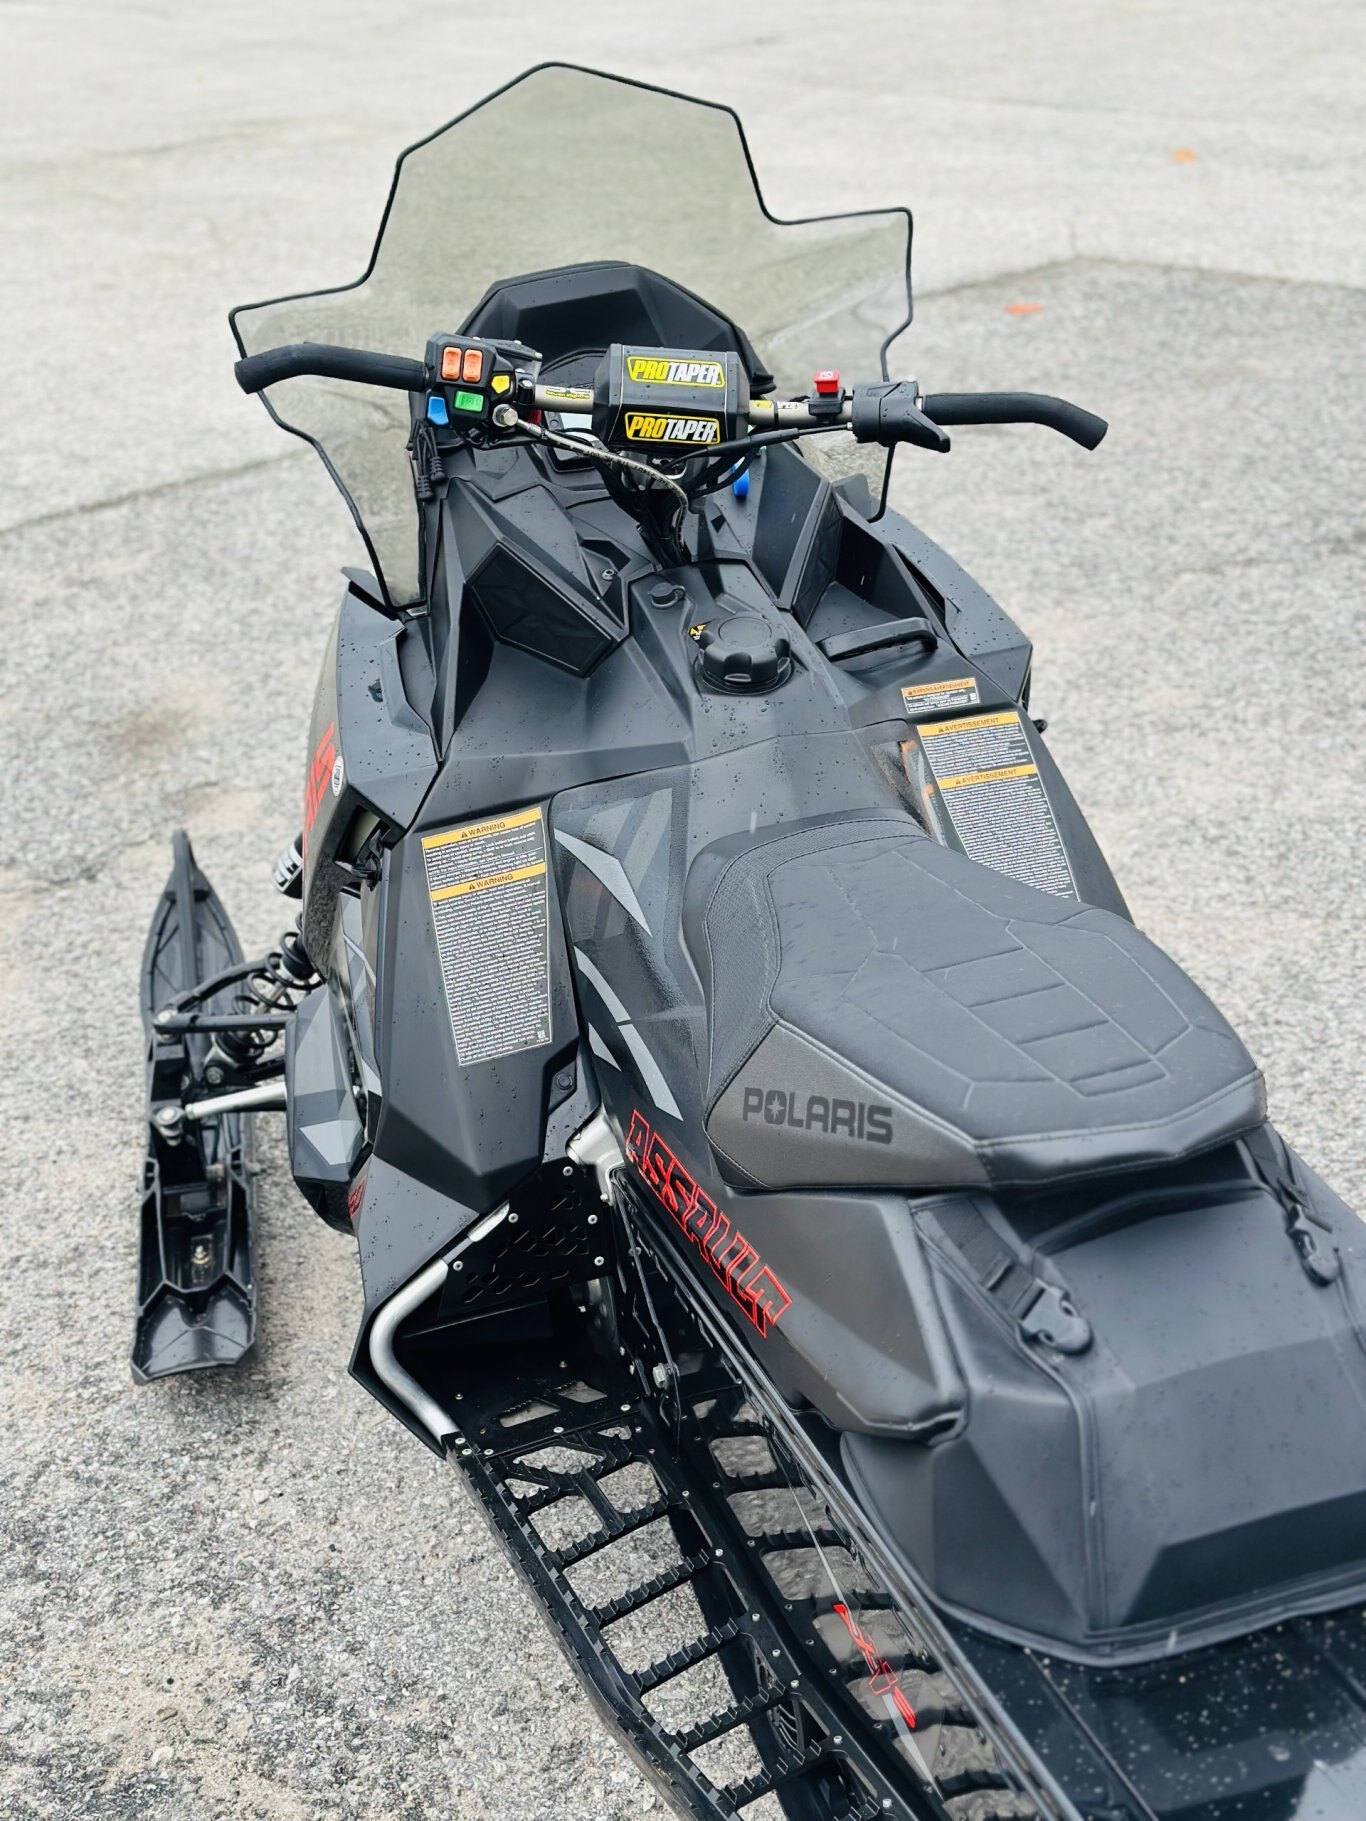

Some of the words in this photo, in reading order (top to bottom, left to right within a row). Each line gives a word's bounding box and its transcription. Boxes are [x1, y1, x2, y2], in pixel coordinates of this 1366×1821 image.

[631, 360, 719, 385] PROTAPER
[628, 416, 716, 443] PROTAPER
[944, 717, 999, 733] AVERTISSEMENT
[961, 769, 1017, 784] AVERTISSEMENT
[468, 821, 506, 836] WARNING
[476, 873, 514, 888] WARNING
[742, 1087, 893, 1145] POLARIS
[625, 1109, 793, 1339] ASSAULT
